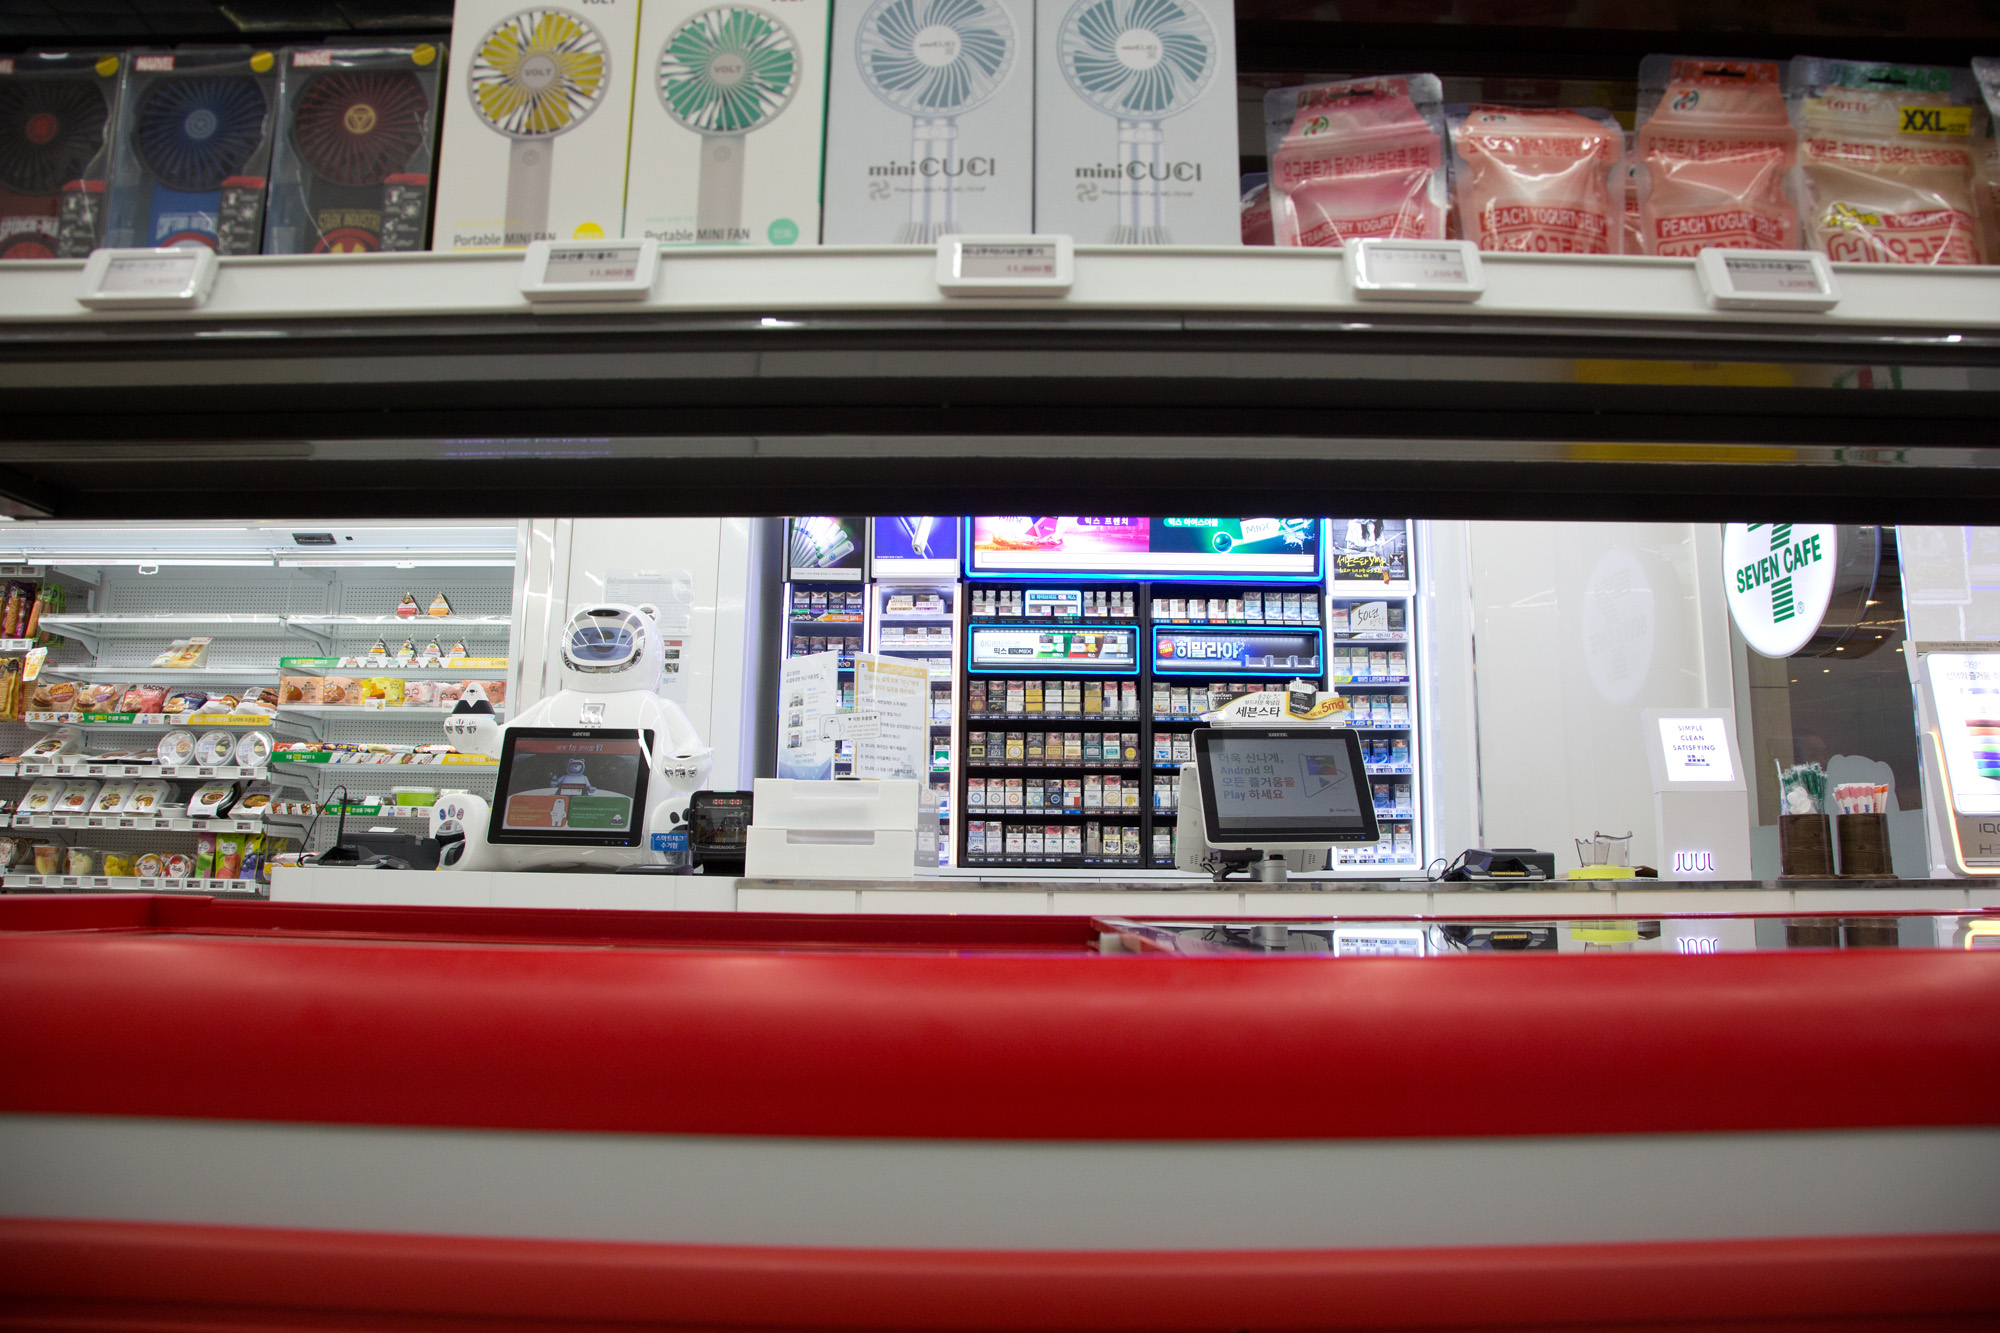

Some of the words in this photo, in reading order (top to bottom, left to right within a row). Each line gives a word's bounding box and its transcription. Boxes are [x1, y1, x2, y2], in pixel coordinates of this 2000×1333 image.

[524, 68, 552, 76] VOLT
[713, 65, 742, 73] VOLT
[1903, 109, 1946, 131] XXL
[869, 156, 996, 178] miniCUCI
[1076, 161, 1202, 183] miniCUCI
[1334, 155, 1365, 176] 들어간
[1531, 209, 1575, 226] YOGURT
[1578, 213, 1605, 233] JELLY
[1662, 217, 1707, 236] PEACH
[645, 229, 694, 242] Portable
[697, 228, 725, 241] MINI
[727, 227, 750, 240] FAN
[1295, 222, 1353, 247] TRAWBERRY
[1356, 215, 1396, 232] YOGURT
[454, 233, 501, 247] Portable
[505, 232, 532, 245] MINI
[535, 231, 556, 243] FAN
[1084, 517, 1100, 526] 믹스
[1104, 517, 1129, 526] 프렌치
[1168, 518, 1182, 526] 믹스
[1184, 518, 1219, 527] 아이스더블
[1737, 555, 1780, 594] SEVEN
[1783, 534, 1822, 572] CAFE
[1176, 640, 1239, 659] 히말라야
[143, 683, 165, 691] BACON
[1236, 706, 1281, 718] 세븐스타
[1321, 700, 1345, 713] 5mg
[1219, 753, 1240, 763] 더욱
[1246, 753, 1284, 764] 신나게,
[1221, 766, 1260, 775] Android
[1264, 765, 1274, 776] 의
[1222, 777, 1245, 788] 모든
[1249, 777, 1295, 788] 즐거움을
[1224, 790, 1245, 801] Play
[1250, 789, 1283, 800] 하세요
[1675, 852, 1713, 871] JUUL
